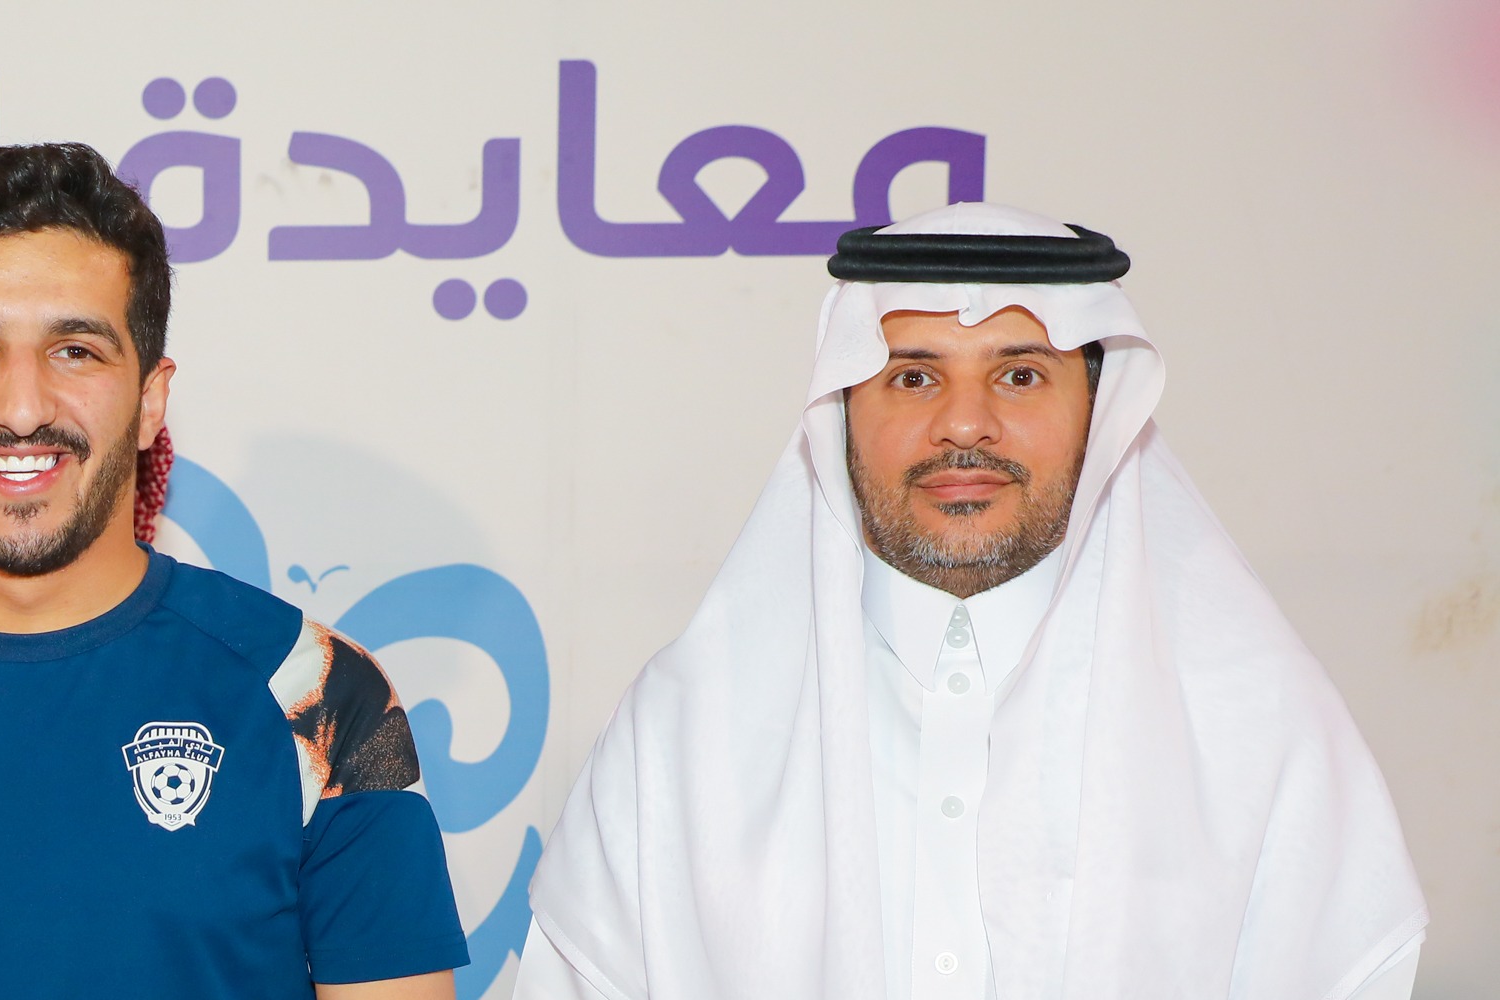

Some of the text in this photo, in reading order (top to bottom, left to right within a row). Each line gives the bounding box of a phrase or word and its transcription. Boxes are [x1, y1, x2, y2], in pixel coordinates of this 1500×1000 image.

[136, 749, 210, 764] ALFAYHA CLUB
[164, 813, 182, 821] 1953
